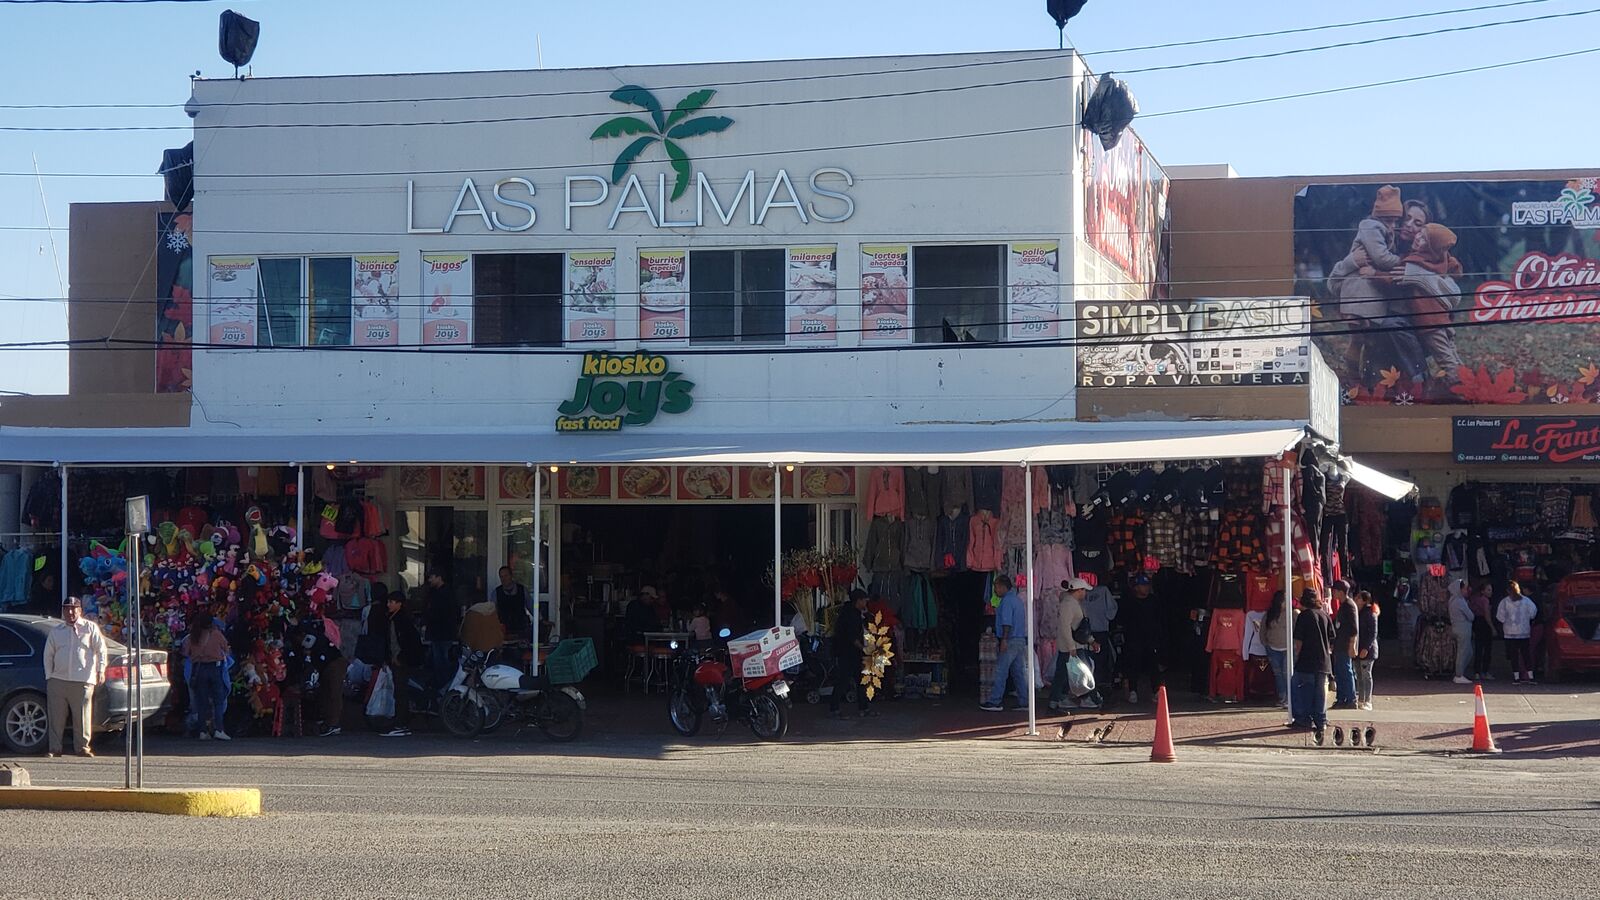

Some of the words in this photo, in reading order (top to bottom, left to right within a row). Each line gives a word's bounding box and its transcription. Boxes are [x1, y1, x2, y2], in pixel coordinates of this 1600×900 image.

[406, 175, 537, 233] LAS
[564, 166, 855, 231] PALMAS
[1514, 209, 1546, 223] LAS
[1552, 207, 1600, 223] PALM
[791, 253, 831, 261] milanesa
[874, 252, 901, 260] tortas
[1022, 249, 1045, 258] pollo
[431, 260, 461, 272] jugos
[574, 258, 611, 266] ensalada
[649, 256, 680, 264] burrito
[870, 260, 905, 268] ahogadas
[650, 264, 679, 272] especial
[1082, 304, 1198, 335] SIMPLY
[1202, 299, 1305, 334] BASIC
[583, 353, 666, 375] kiosko
[1082, 376, 1156, 386] ROPA
[1172, 373, 1304, 385] VAQUERA
[557, 372, 696, 427] Joy's
[557, 417, 585, 430] fast
[587, 416, 621, 430] food
[1491, 418, 1529, 449] La
